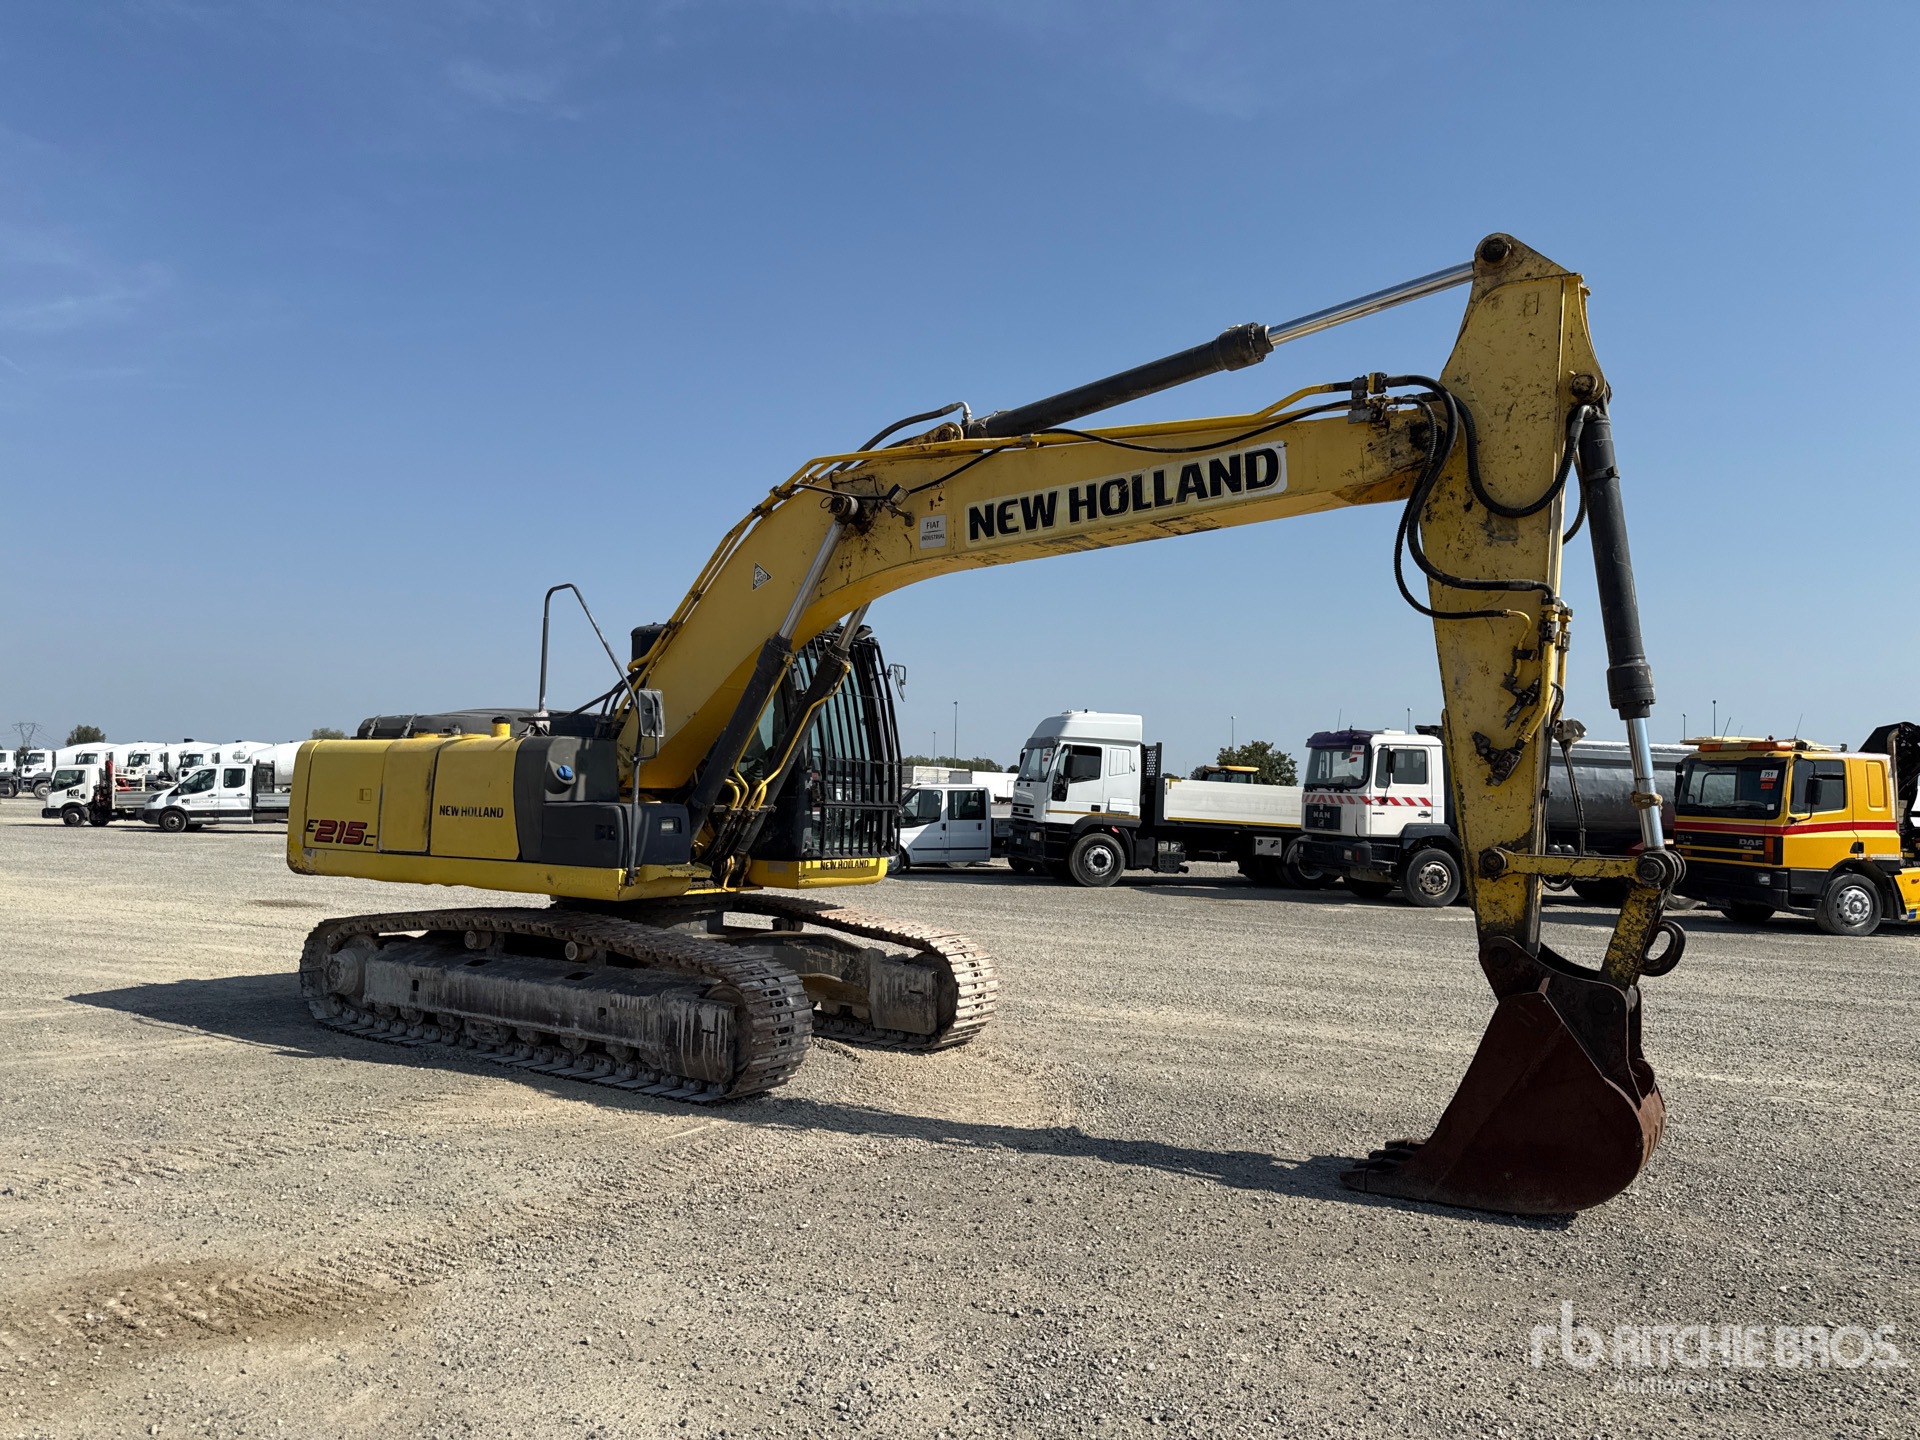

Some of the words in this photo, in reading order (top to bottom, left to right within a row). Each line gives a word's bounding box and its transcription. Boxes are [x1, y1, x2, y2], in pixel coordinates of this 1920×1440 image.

[969, 490, 1058, 541] NEW
[1069, 447, 1280, 523] HOLLAND
[926, 521, 940, 529] FIAT
[921, 533, 945, 541] INDUSTRIAL
[439, 805, 459, 817] NEW
[461, 806, 504, 818] HOLLAND
[820, 861, 837, 870] NEW
[839, 859, 869, 869] HOLLAND
